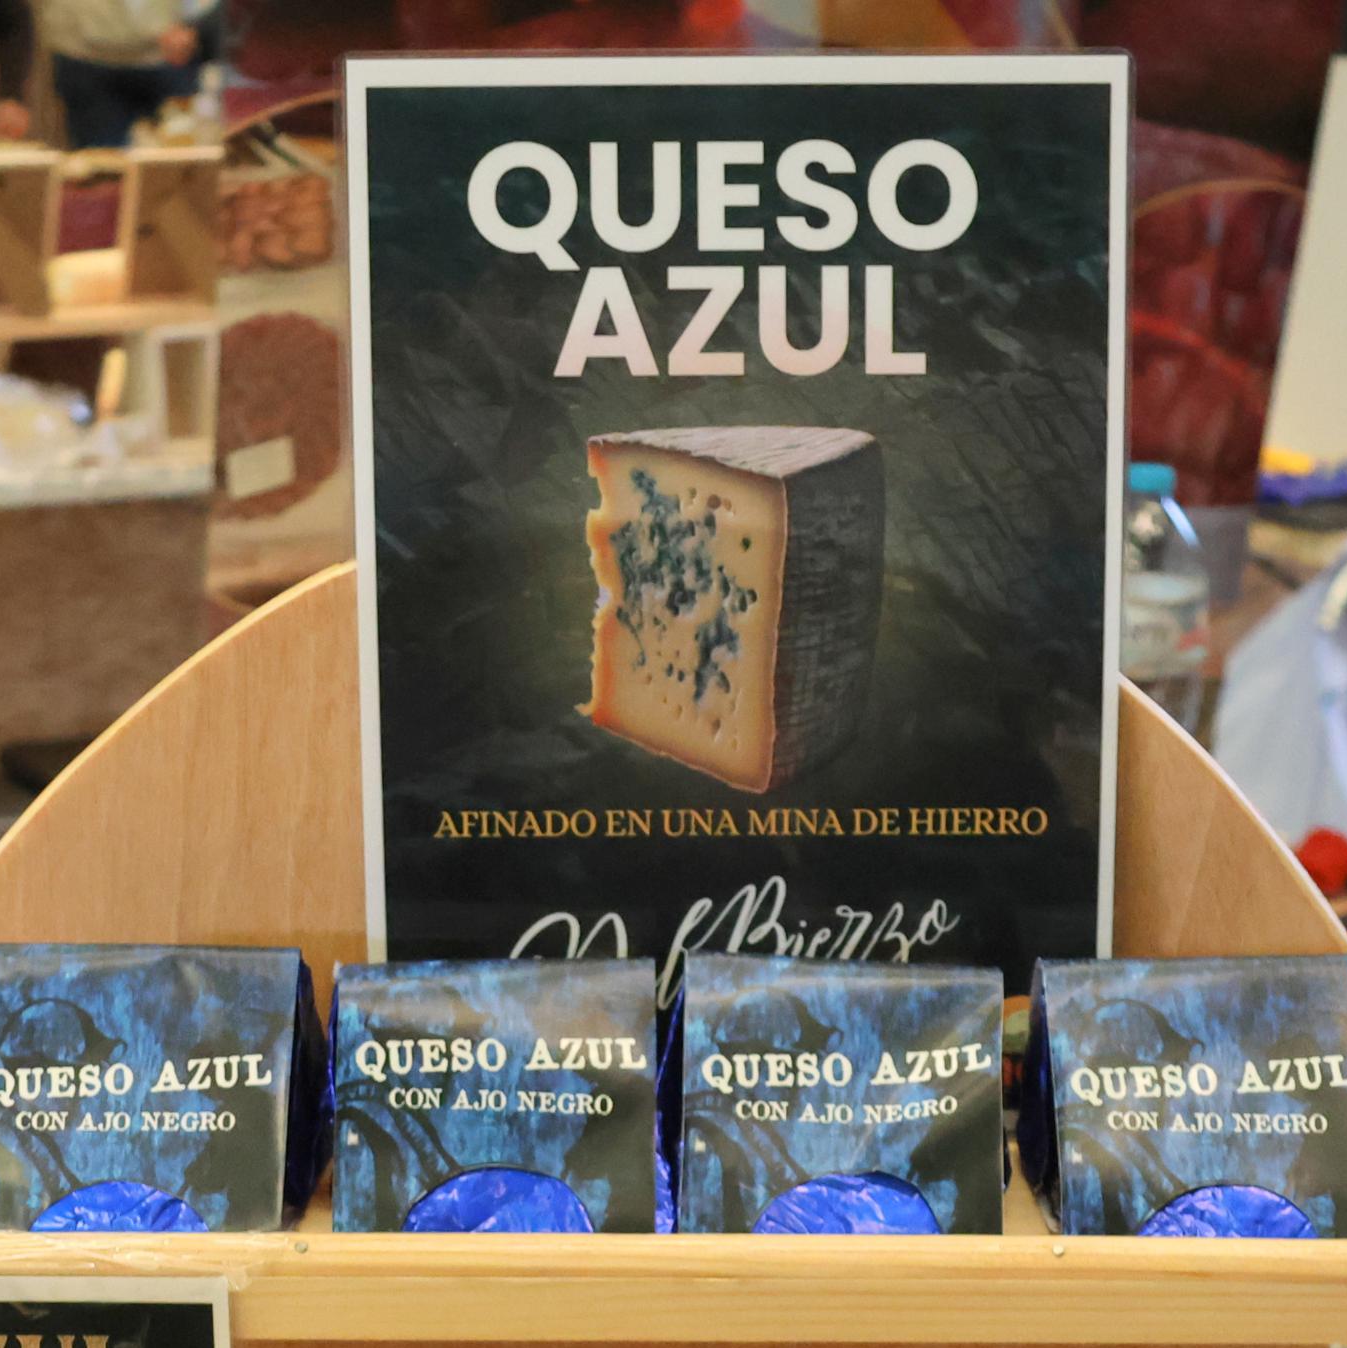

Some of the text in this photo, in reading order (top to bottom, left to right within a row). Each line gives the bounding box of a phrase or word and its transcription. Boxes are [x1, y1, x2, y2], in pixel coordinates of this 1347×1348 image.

[467, 139, 978, 271] QUESO
[554, 265, 927, 377] AZUL
[434, 807, 1048, 838] AFINADO EN UNA MINA DE HIERRO
[152, 1054, 272, 1092] AZUL
[355, 1038, 646, 1083] QUESO AZUL
[701, 1043, 992, 1095] QUESO AZUL
[389, 1087, 613, 1116] CON AJO NEGRO
[1071, 1064, 1218, 1107] QUESO
[15, 1111, 236, 1132] CON AJO NEGRO
[735, 1096, 958, 1123] CON AJO NEGRO
[1107, 1111, 1328, 1135] CON AJO NEGRO
